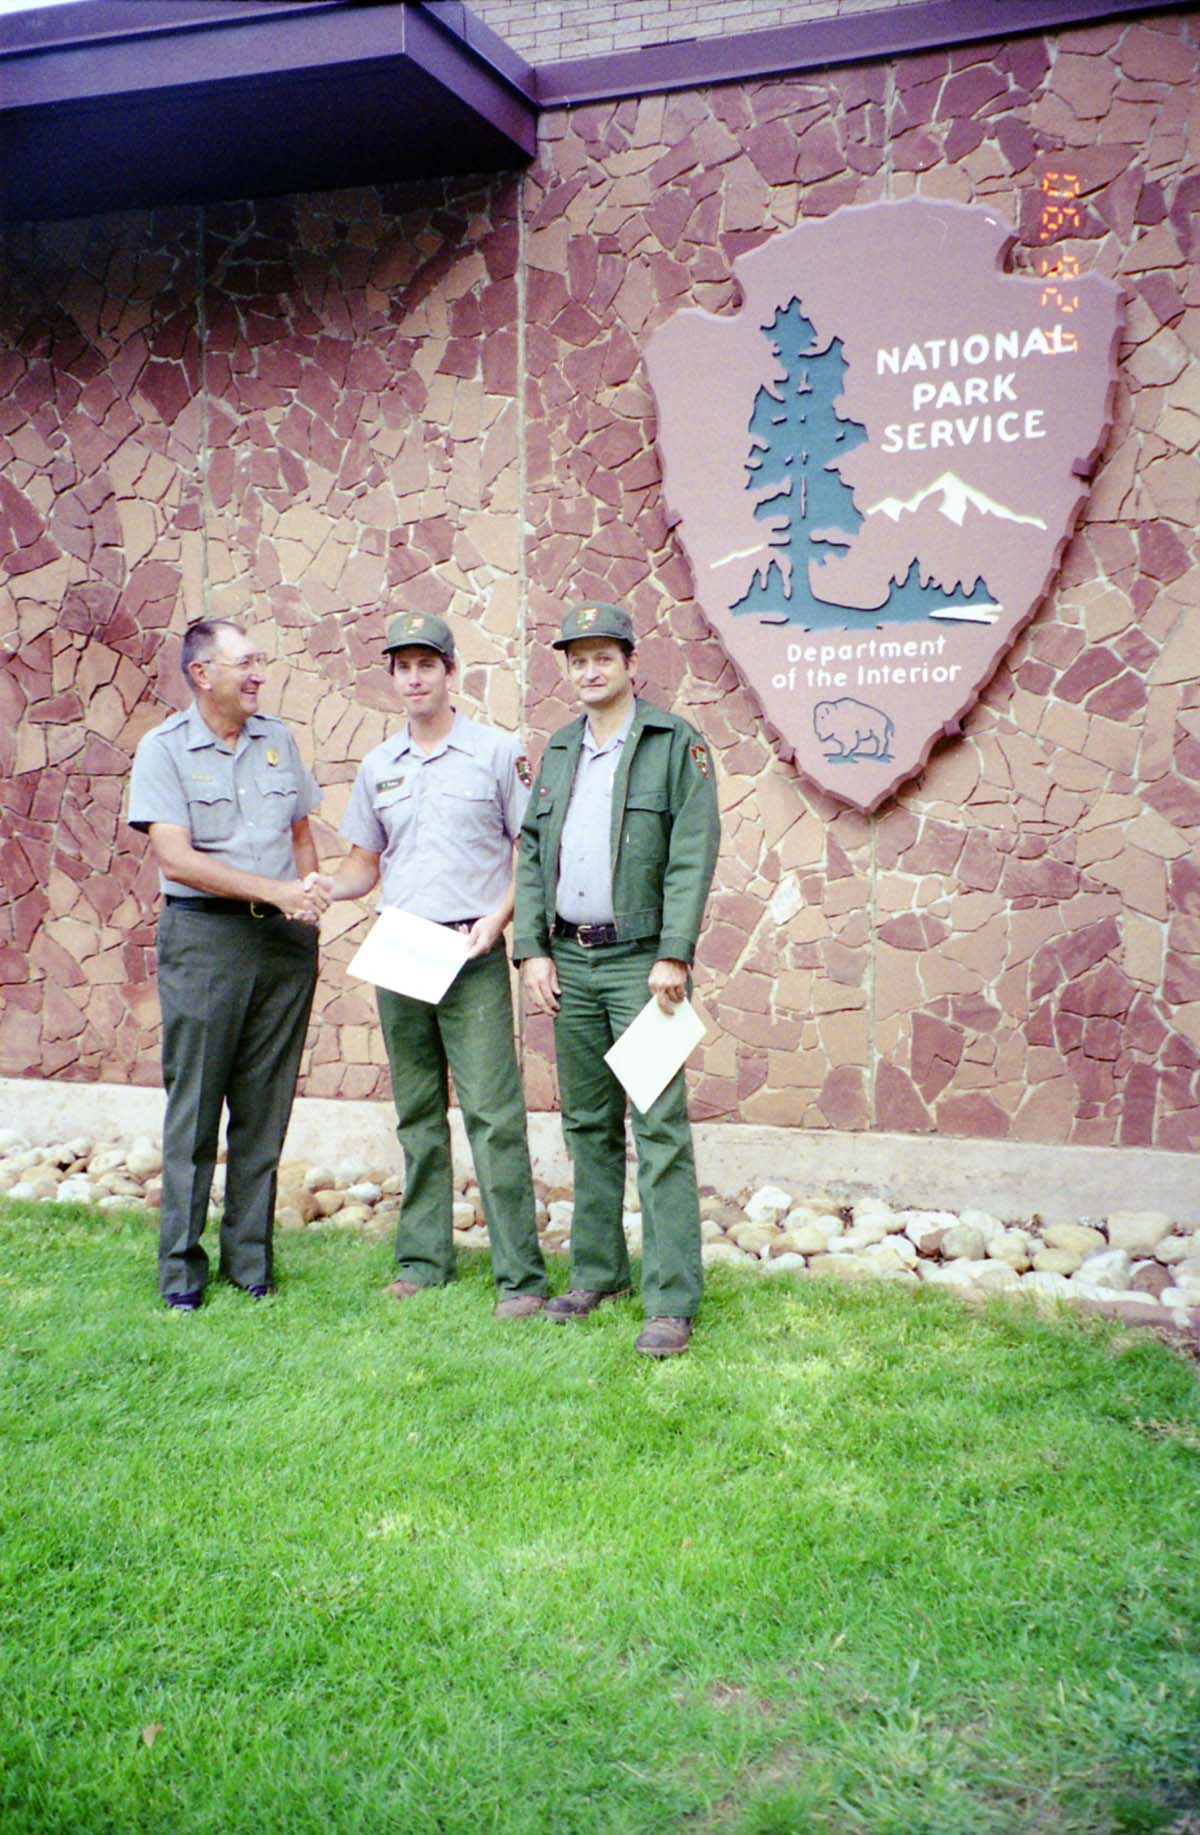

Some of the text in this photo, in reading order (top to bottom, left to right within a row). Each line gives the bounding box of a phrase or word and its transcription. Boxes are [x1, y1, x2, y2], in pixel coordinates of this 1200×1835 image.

[876, 324, 1074, 375] NATIONAL
[912, 372, 1018, 411] PARK
[880, 409, 1047, 453] SERVICE
[786, 634, 947, 666] Department
[771, 663, 962, 689] of the Interior
